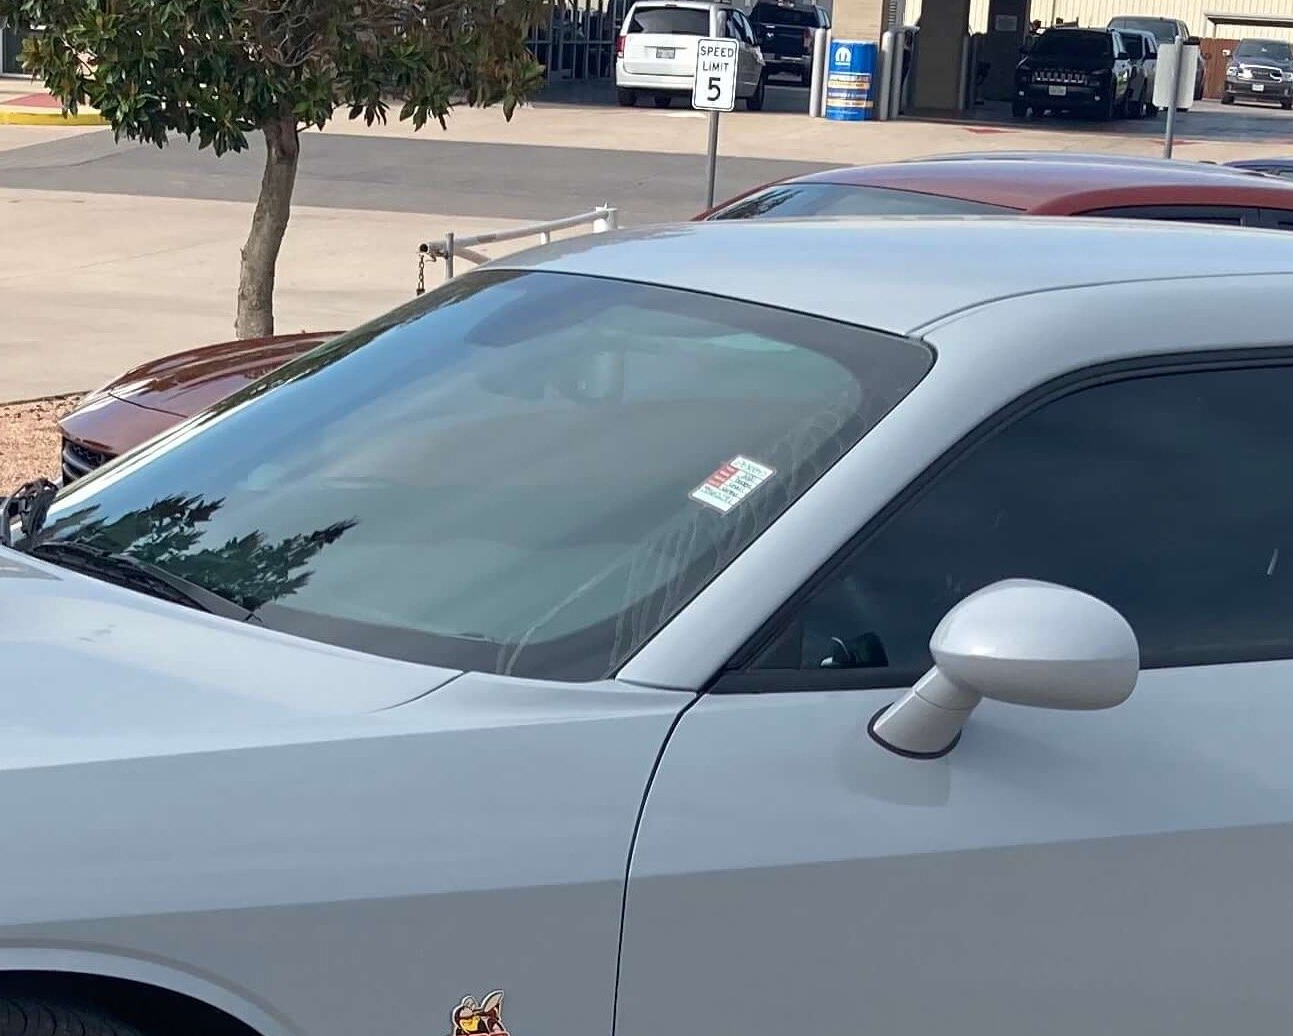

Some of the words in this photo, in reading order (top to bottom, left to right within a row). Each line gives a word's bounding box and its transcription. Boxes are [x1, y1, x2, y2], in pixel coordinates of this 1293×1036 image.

[700, 45, 734, 58] SPEED
[702, 60, 729, 73] LIMIT
[707, 76, 721, 102] 5
